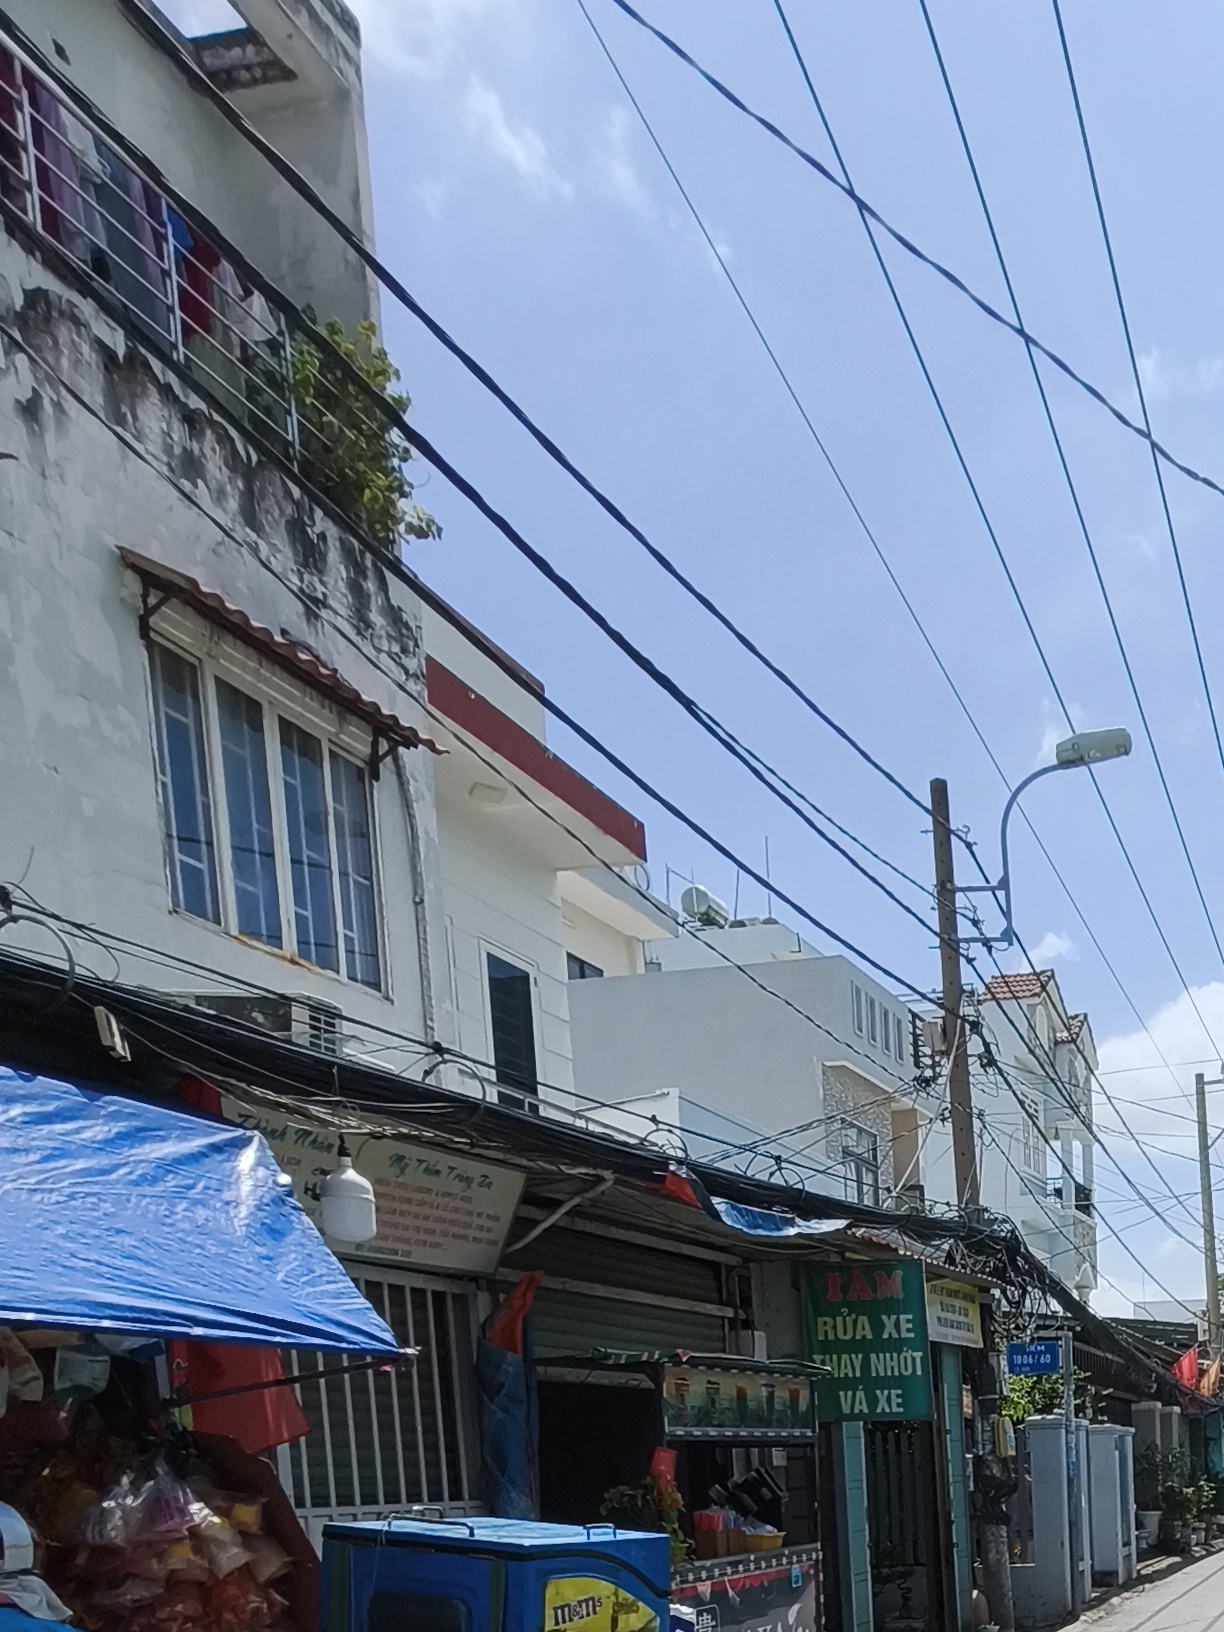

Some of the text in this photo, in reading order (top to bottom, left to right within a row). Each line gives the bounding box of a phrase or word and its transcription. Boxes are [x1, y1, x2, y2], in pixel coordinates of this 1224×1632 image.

[822, 1265, 905, 1300] TÂM
[816, 1308, 873, 1341] RỬA
[880, 1314, 915, 1339] XE
[812, 1347, 924, 1378] THAY NHỚT
[838, 1385, 904, 1414] VÁ XE
